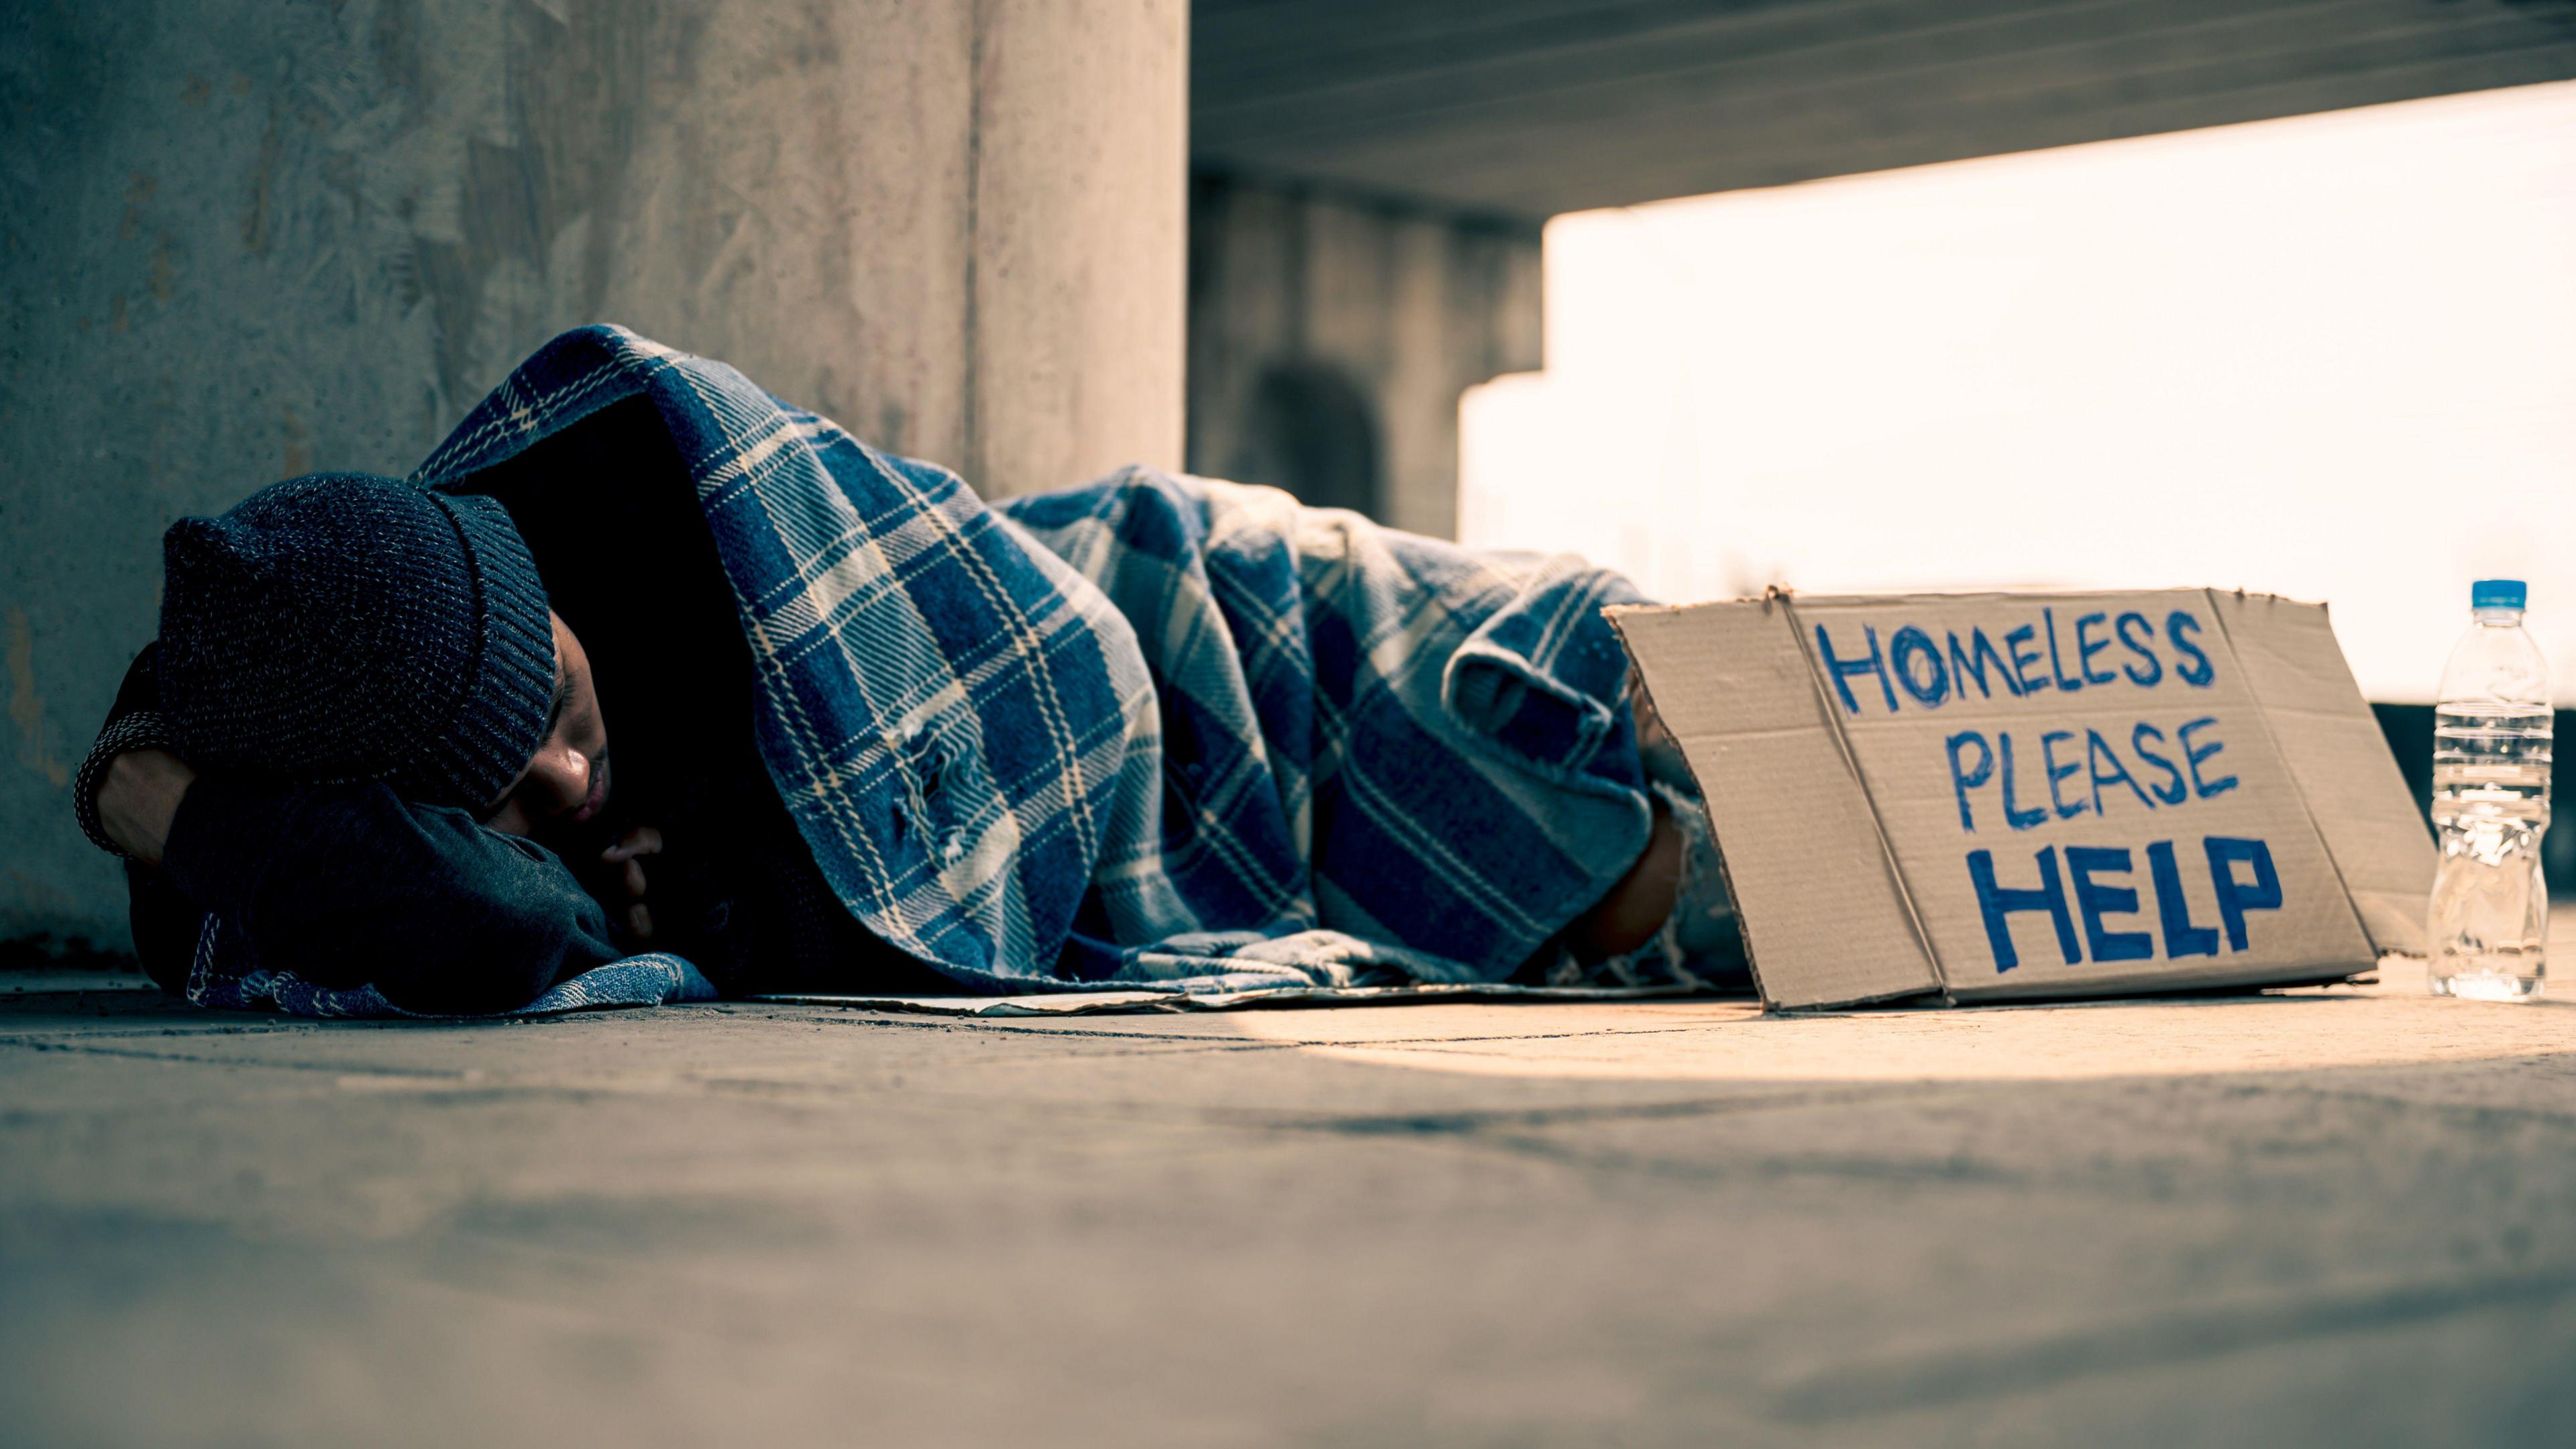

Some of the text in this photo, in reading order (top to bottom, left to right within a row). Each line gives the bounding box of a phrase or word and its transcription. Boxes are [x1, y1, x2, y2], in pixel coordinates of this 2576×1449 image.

[1816, 608, 2216, 715] HOMELESS
[1945, 717, 2239, 833] PLEASE
[1966, 836, 2284, 974] HELP
